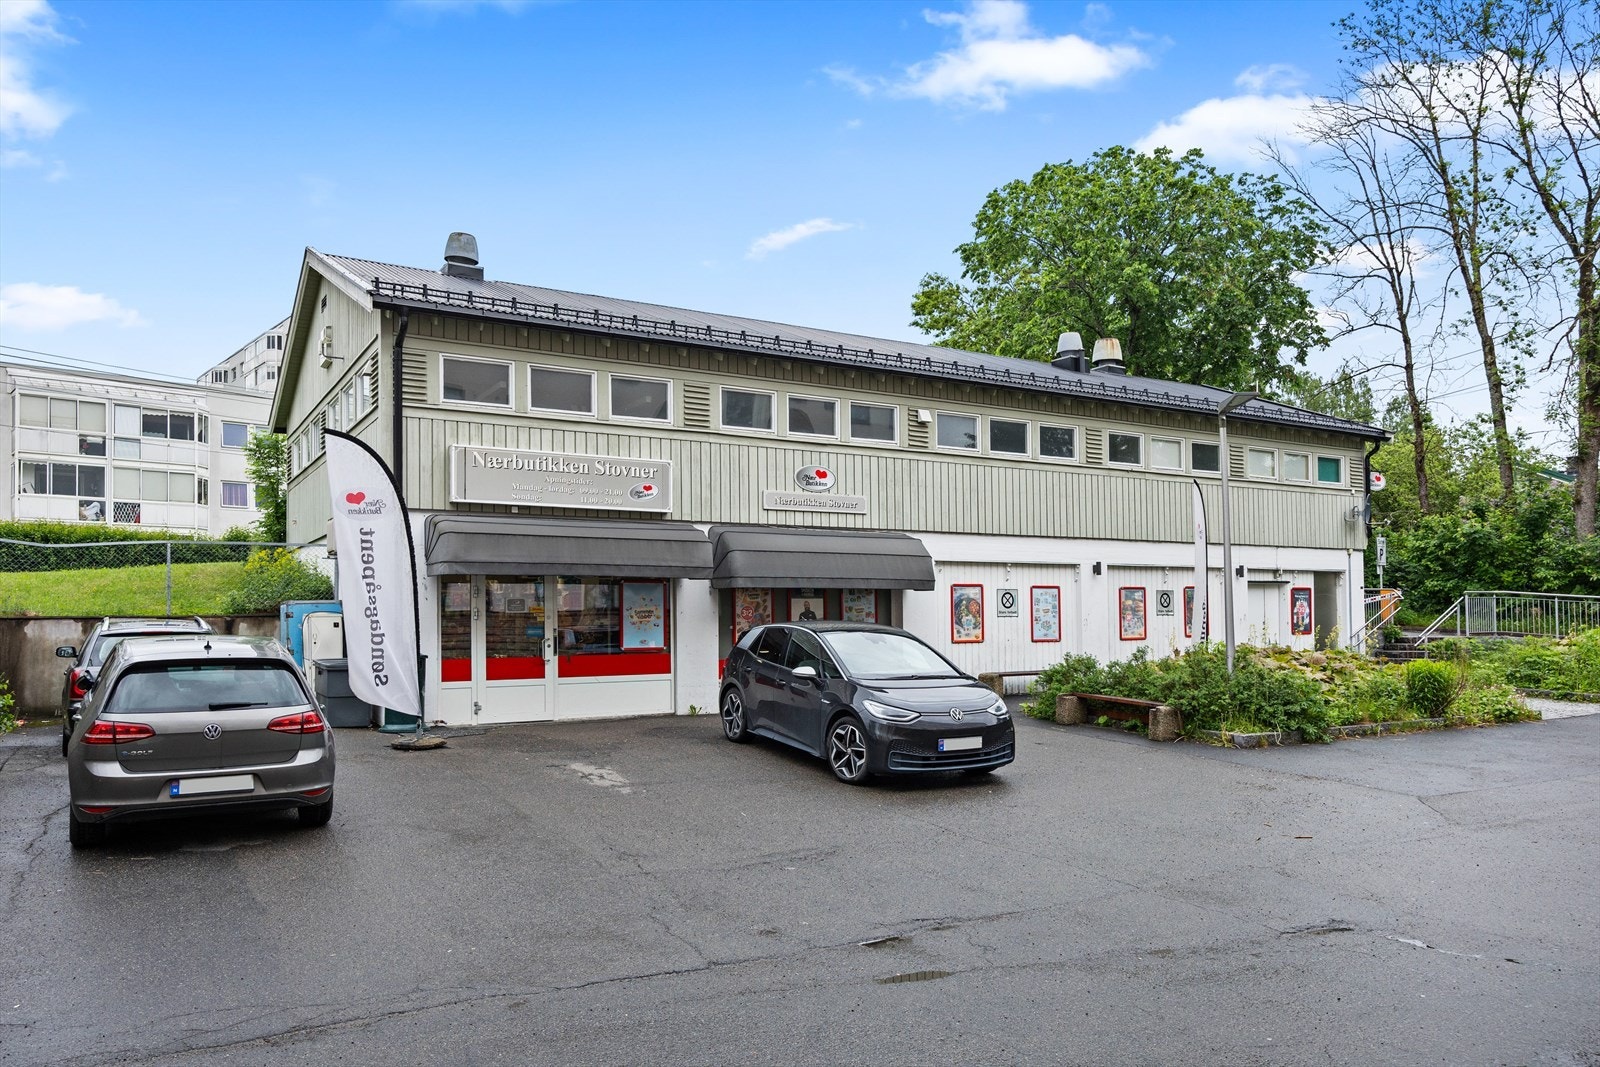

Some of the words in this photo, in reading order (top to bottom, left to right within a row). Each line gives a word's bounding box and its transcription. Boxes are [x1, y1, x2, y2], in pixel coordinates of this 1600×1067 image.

[472, 451, 590, 474] Nærbutikken
[594, 459, 658, 479] Stovner
[774, 495, 827, 508] Nærbutikken
